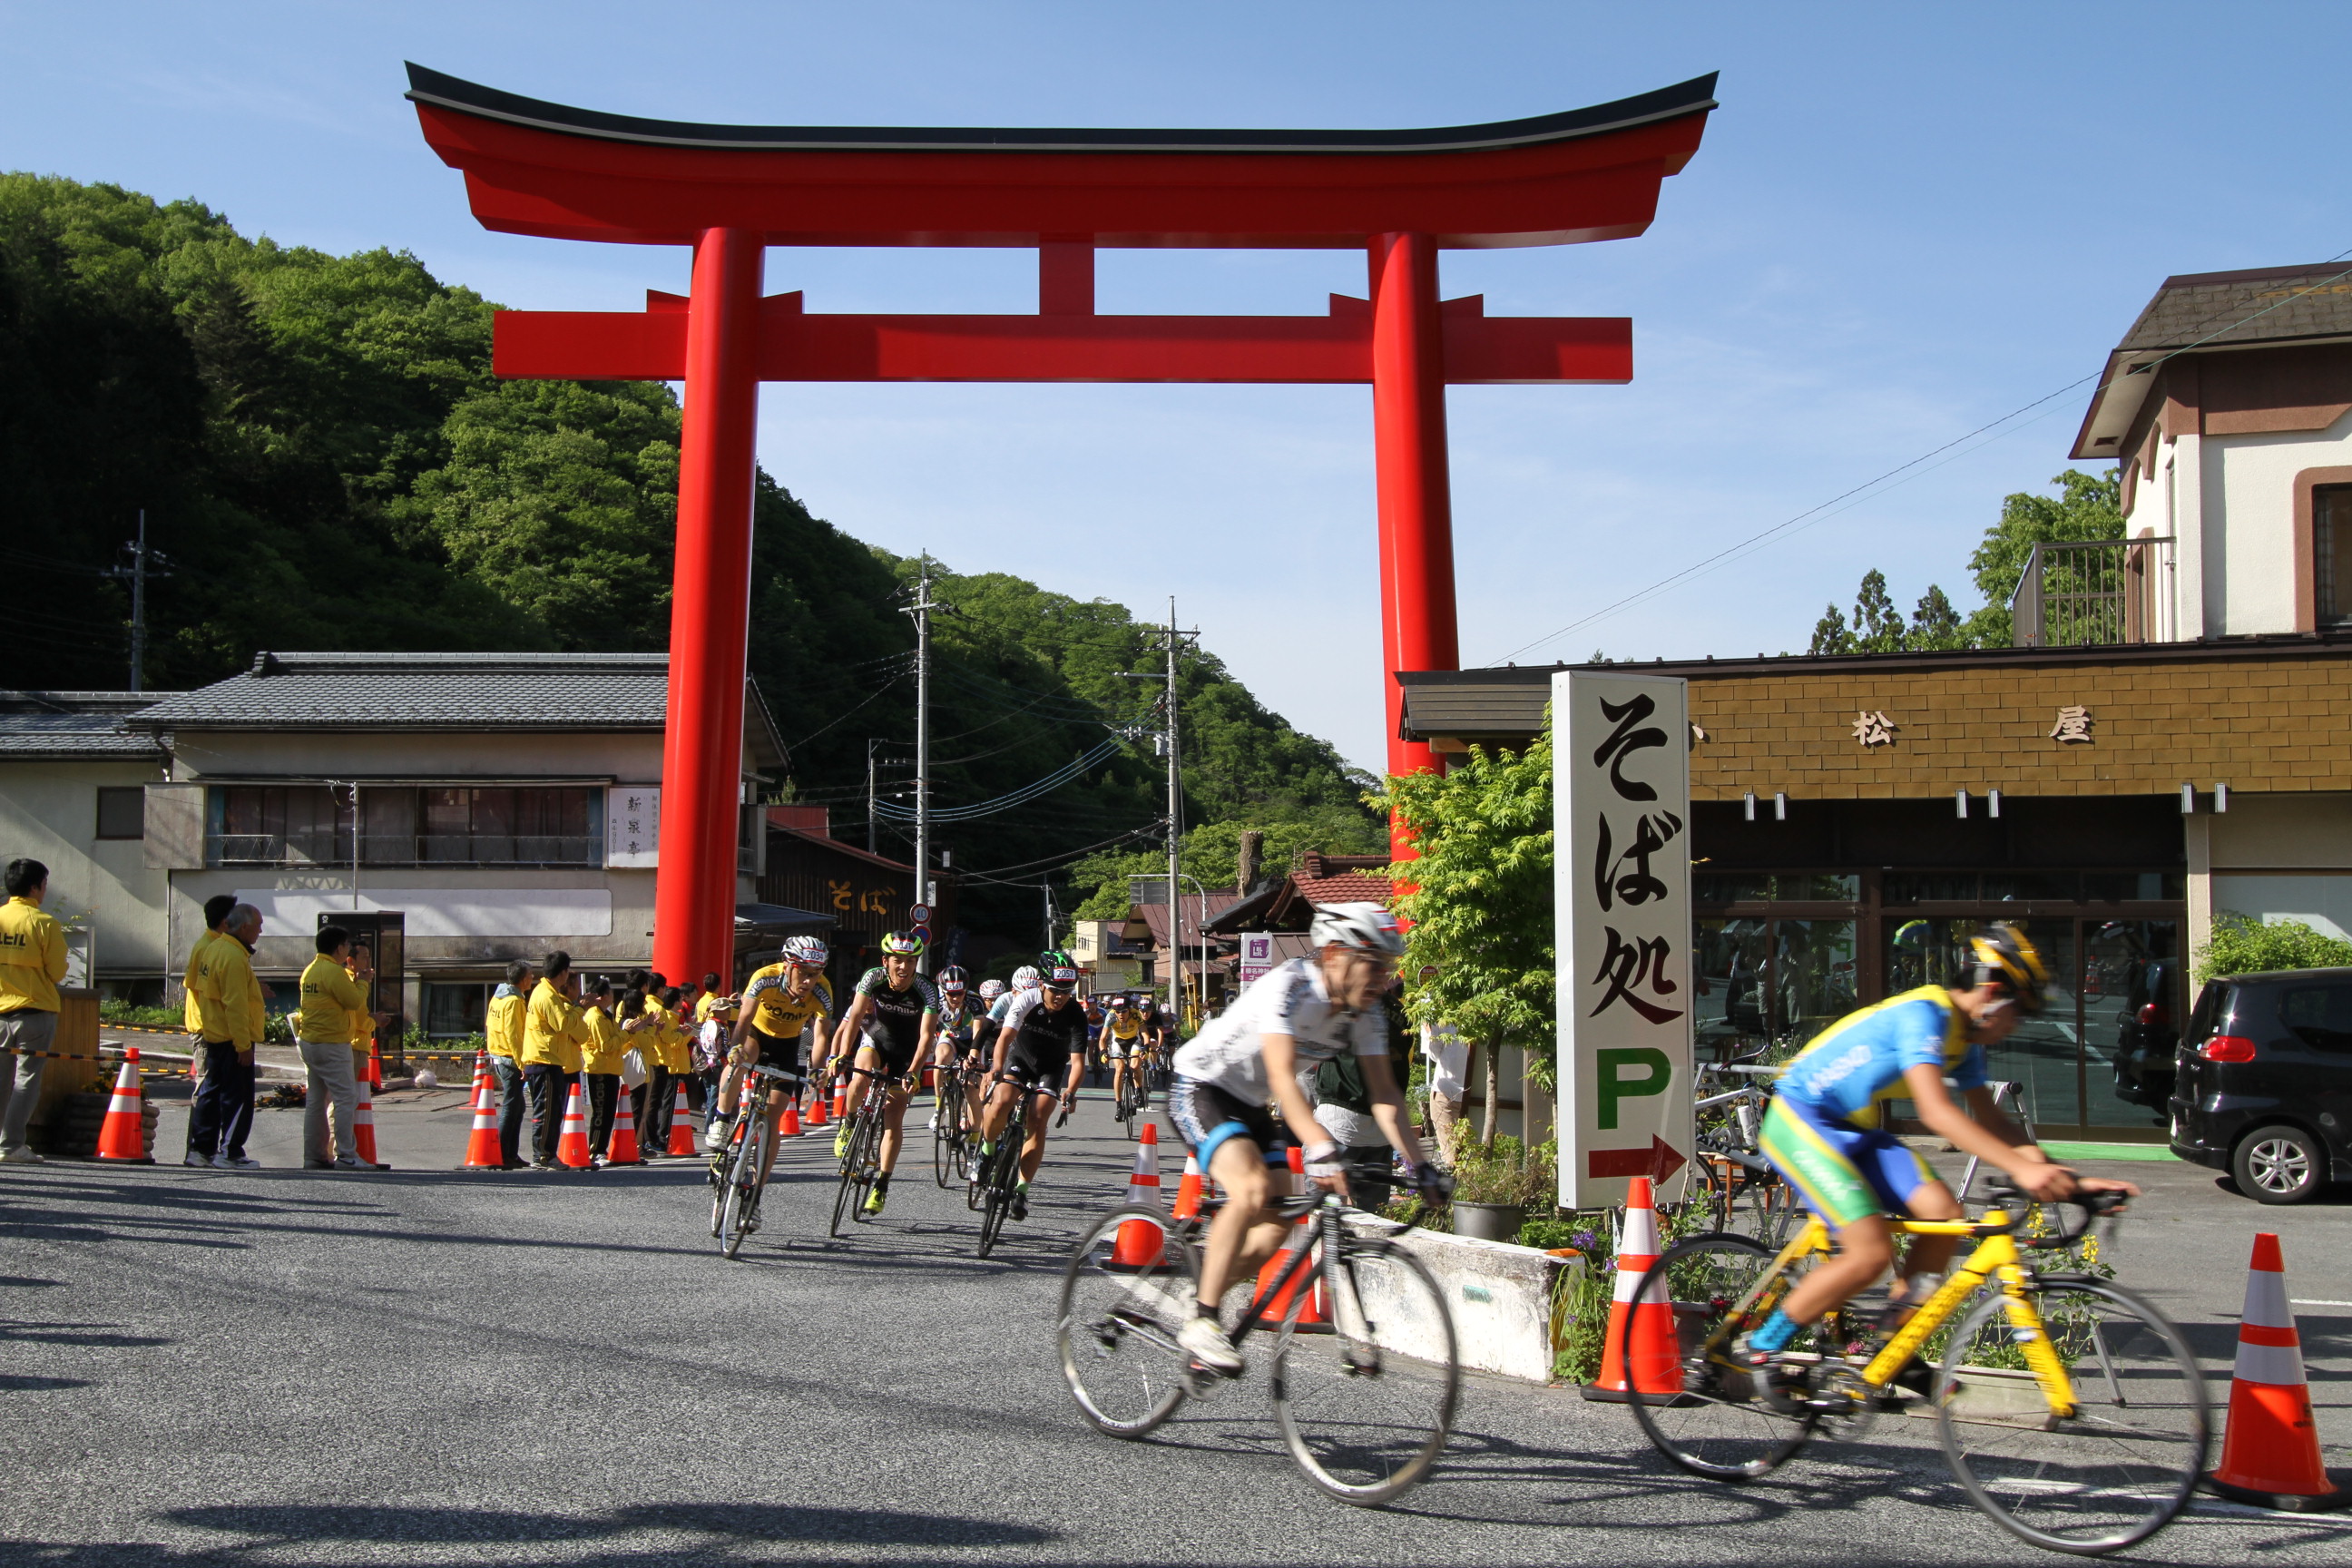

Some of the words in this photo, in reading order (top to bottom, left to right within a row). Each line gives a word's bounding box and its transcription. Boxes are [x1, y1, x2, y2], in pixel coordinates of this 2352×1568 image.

[1691, 704, 2091, 746] 松屋
[1588, 692, 1684, 1025] そば処
[828, 880, 897, 915] そば
[915, 908, 927, 919] 40
[806, 950, 823, 960] 2034
[1056, 969, 1074, 978] 2057
[1596, 1047, 1671, 1131] P
